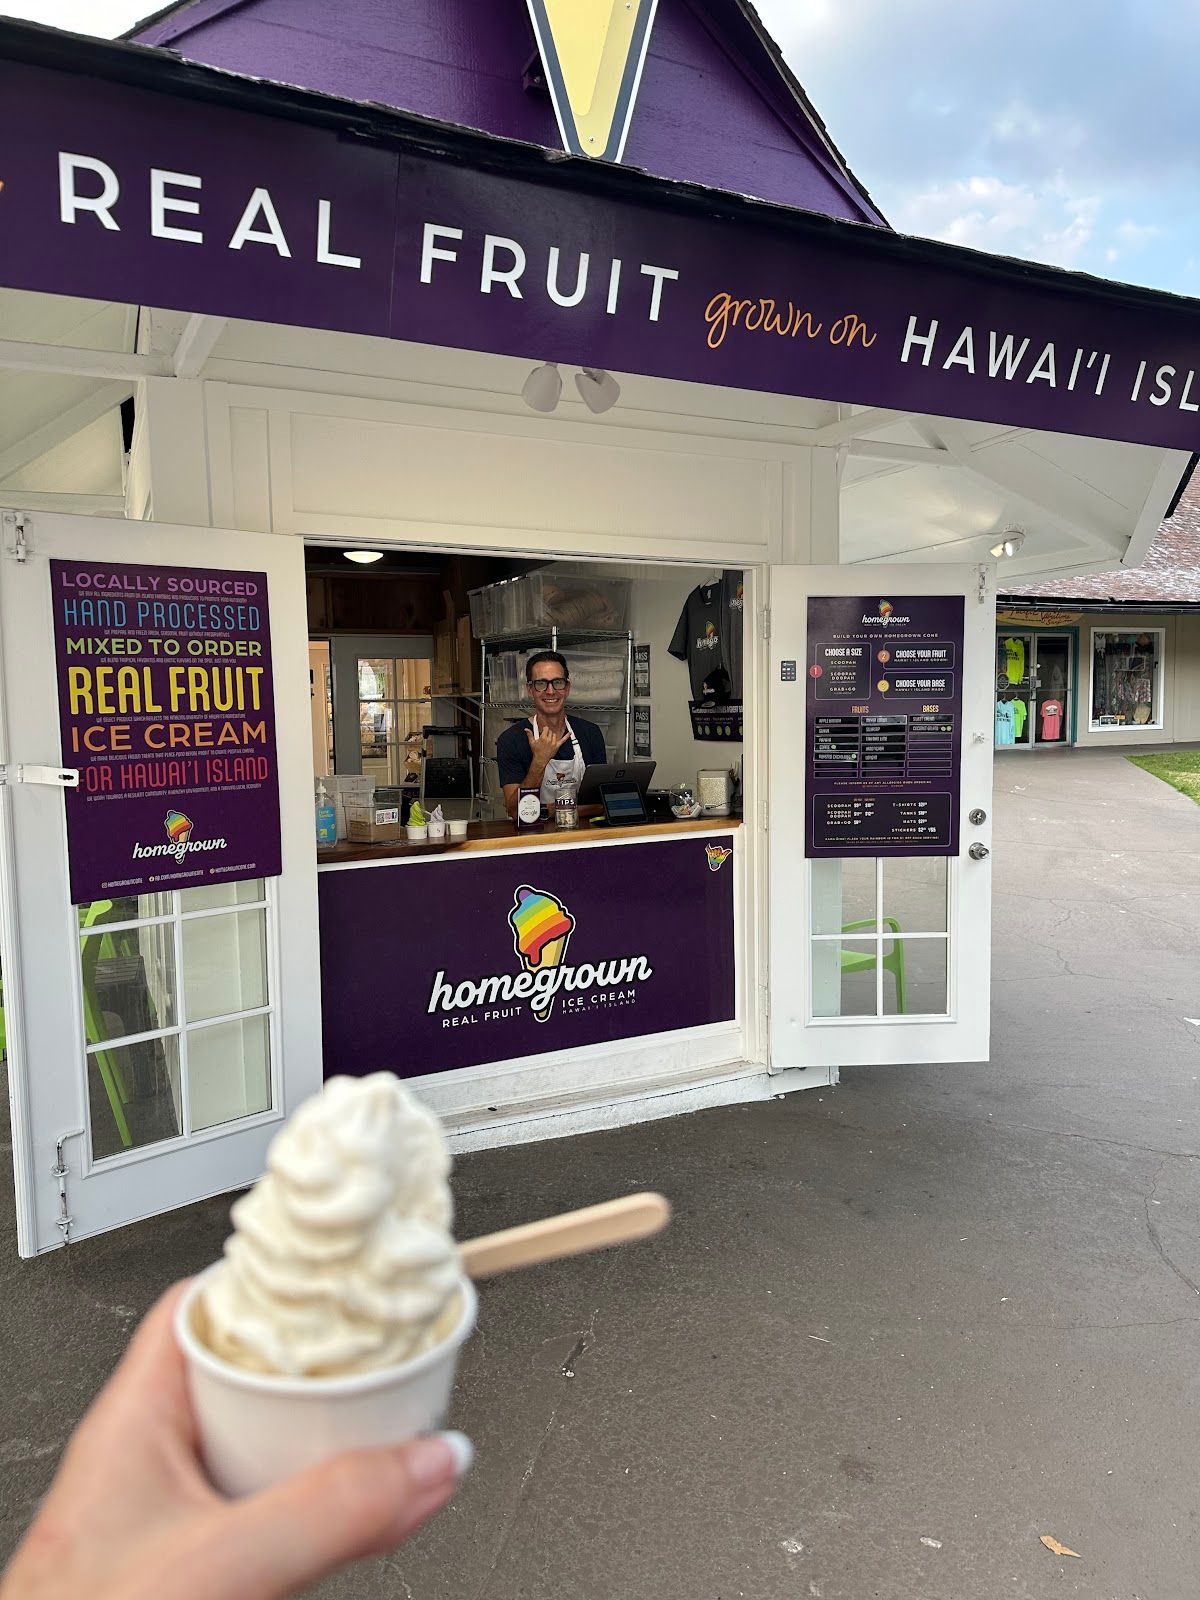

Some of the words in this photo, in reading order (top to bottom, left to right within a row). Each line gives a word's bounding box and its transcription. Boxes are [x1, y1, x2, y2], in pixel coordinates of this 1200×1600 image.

[58, 151, 361, 269] REAL
[420, 222, 679, 321] FRUIT
[704, 292, 822, 348] grown
[829, 314, 877, 347] on
[62, 571, 160, 590] LOCALLY
[167, 578, 258, 596] SOURCED
[64, 599, 127, 627] HAND
[137, 601, 260, 630] PROCESSED
[862, 614, 910, 626] homegrown
[66, 638, 142, 655] MIXED
[148, 639, 180, 655] TO
[187, 640, 262, 656] ORDER
[825, 648, 845, 657] CHOOSE
[846, 648, 850, 656] A
[850, 648, 862, 656] SIZE
[896, 650, 918, 658] CHOOSE
[917, 650, 931, 658] YOUR
[68, 666, 162, 714] REAL
[169, 666, 264, 712] FRUIT
[895, 680, 918, 688] CHOOSE
[932, 679, 946, 687] BASE
[635, 712, 649, 721] PASS
[72, 725, 132, 752] ICE
[144, 721, 267, 749] CREAM
[206, 757, 268, 783] ISLAND
[132, 837, 227, 859] homegrown
[428, 955, 652, 1012] homegrown
[562, 997, 584, 1008] ICE
[591, 989, 636, 1003] CREAM
[604, 999, 636, 1008] ISLAND
[442, 1015, 478, 1028] REAL
[484, 1006, 522, 1021] FRUIT
